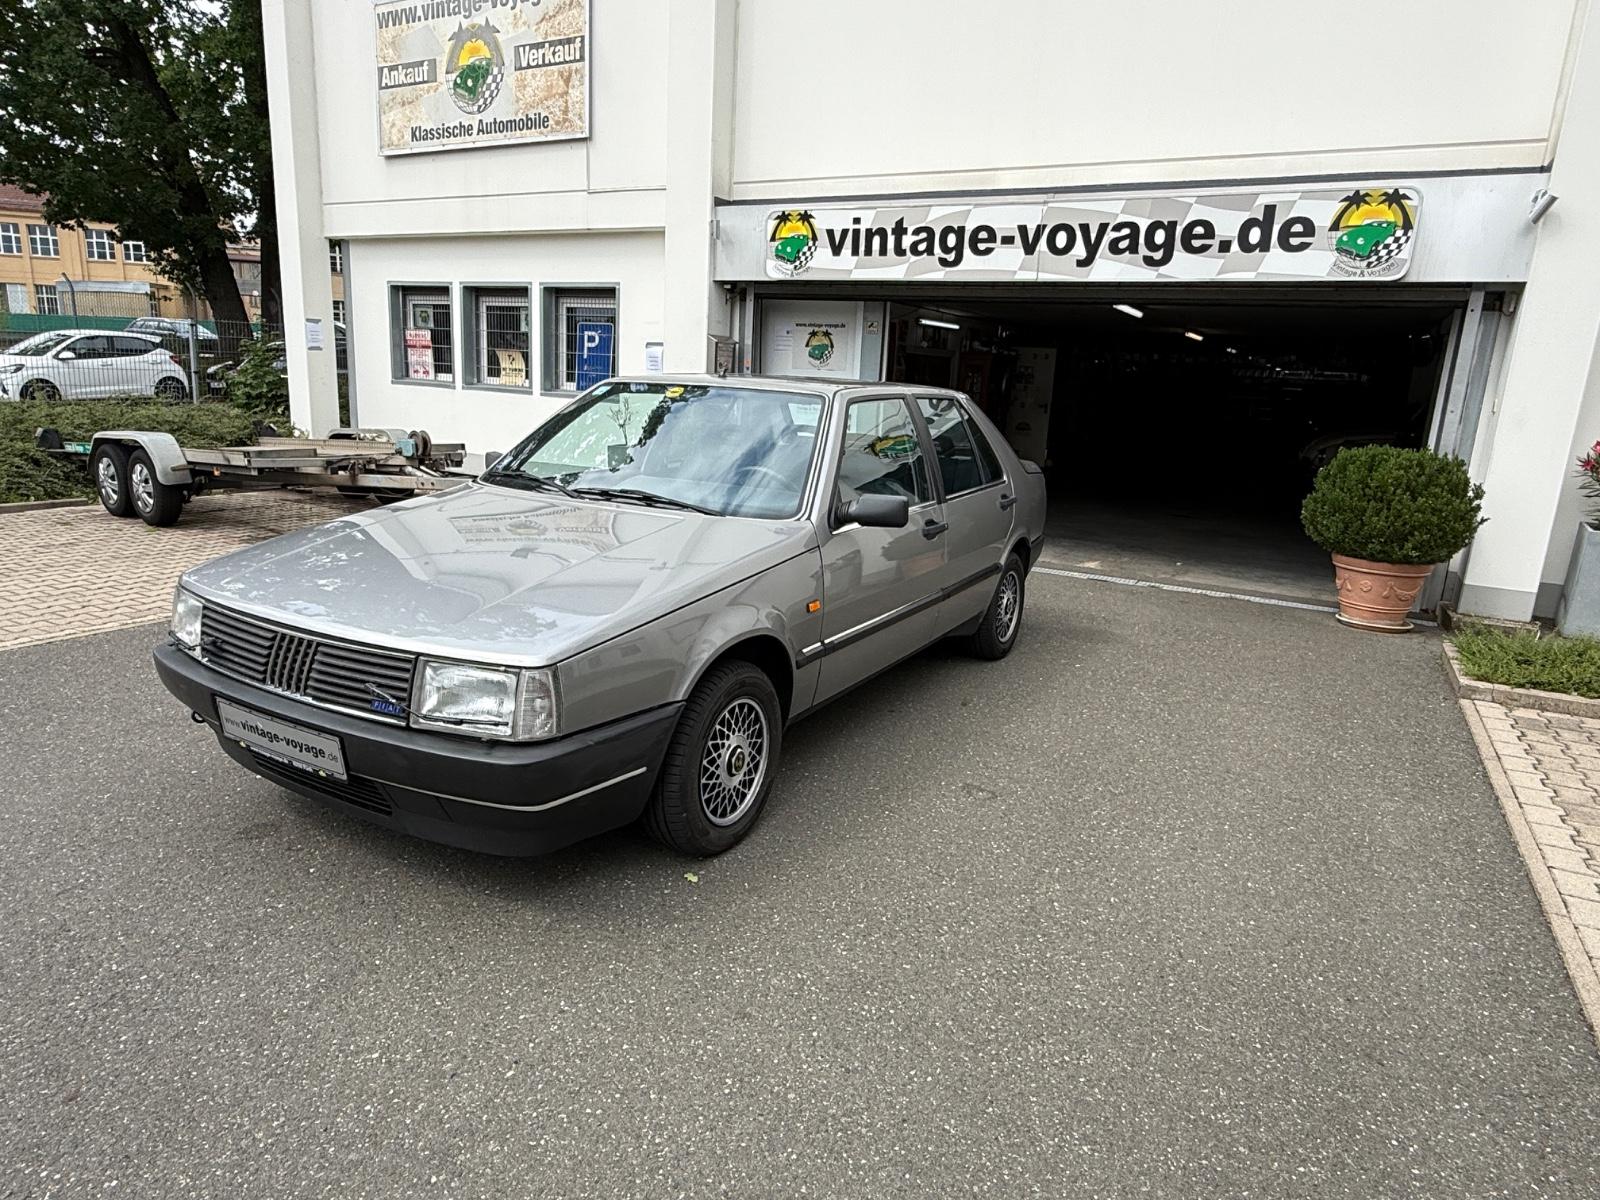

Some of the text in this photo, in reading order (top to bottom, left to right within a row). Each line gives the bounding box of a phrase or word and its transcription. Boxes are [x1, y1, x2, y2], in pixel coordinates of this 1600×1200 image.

[518, 38, 582, 67] Verkauf
[381, 64, 429, 87] Ankauf
[410, 113, 550, 142] Klassische Automobile
[825, 204, 1316, 268] vintage-voyage.de
